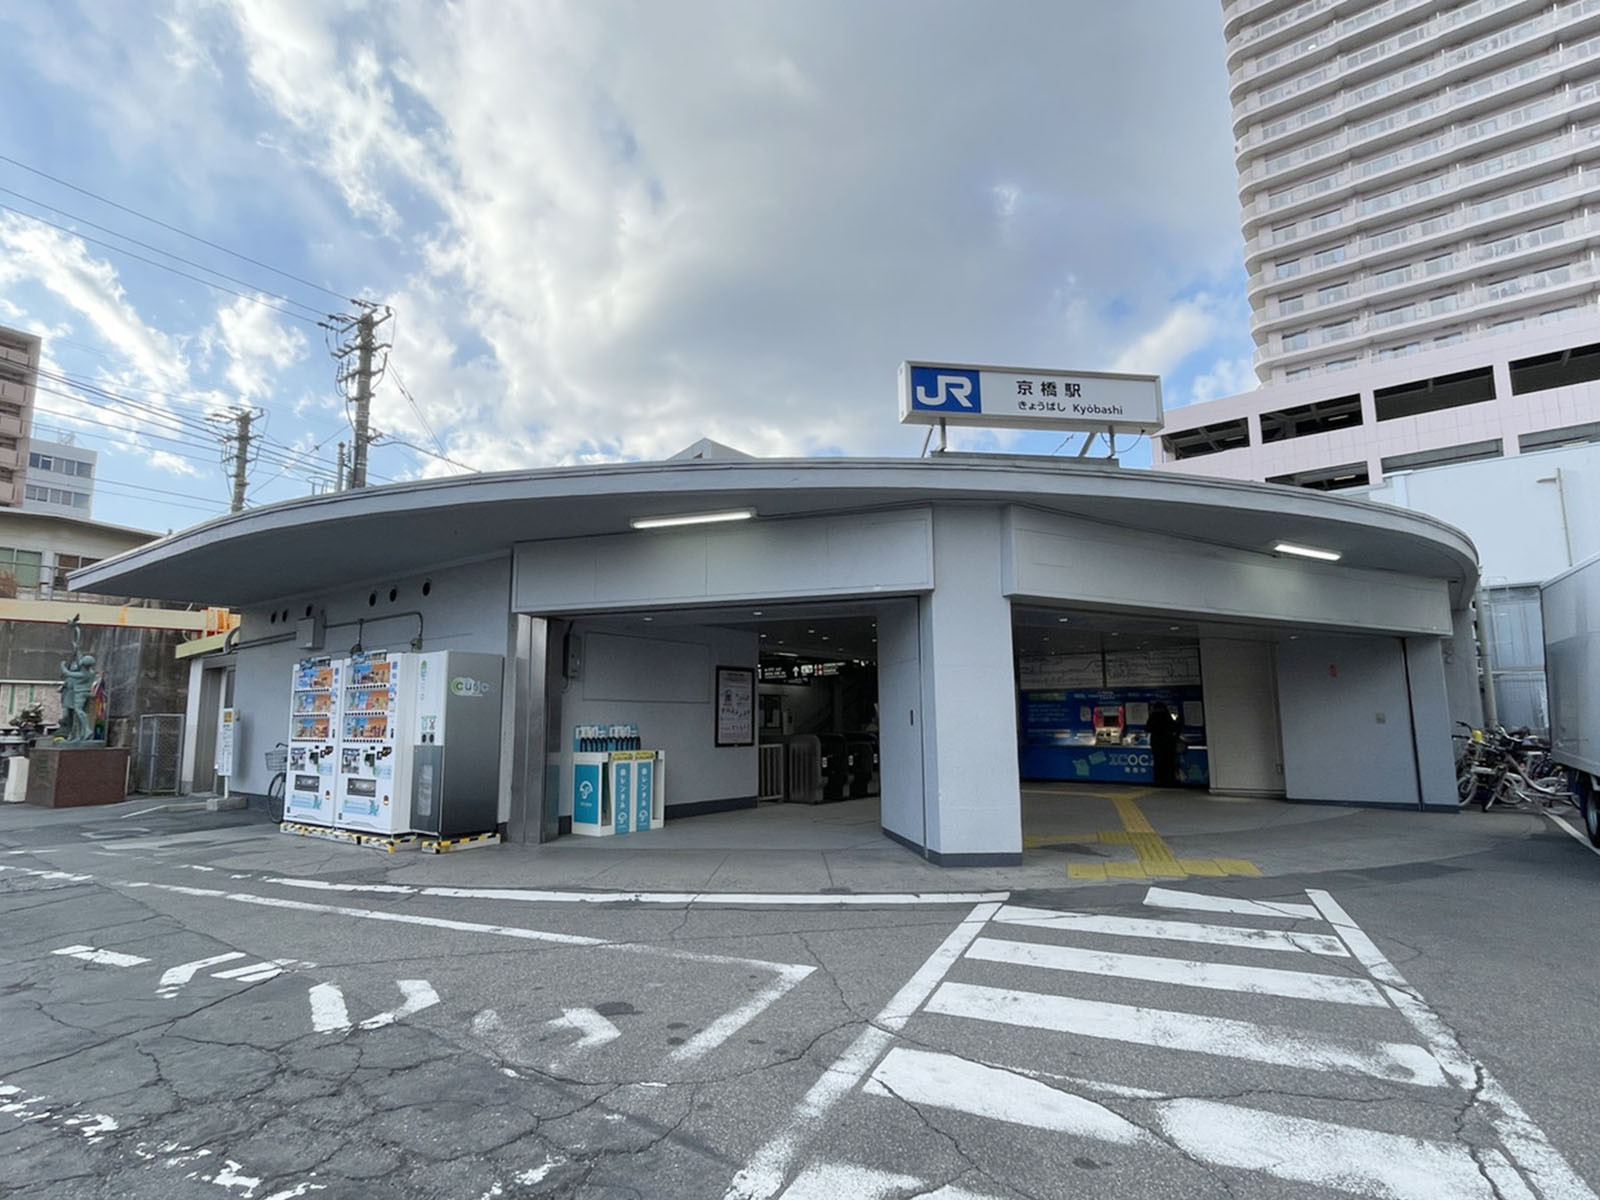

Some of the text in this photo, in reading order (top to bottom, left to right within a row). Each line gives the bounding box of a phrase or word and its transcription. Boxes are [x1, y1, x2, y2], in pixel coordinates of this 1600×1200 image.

[916, 375, 973, 408] JR
[1016, 380, 1081, 398] 京橋駅
[1018, 400, 1123, 415] きょうばし Kyōbashi
